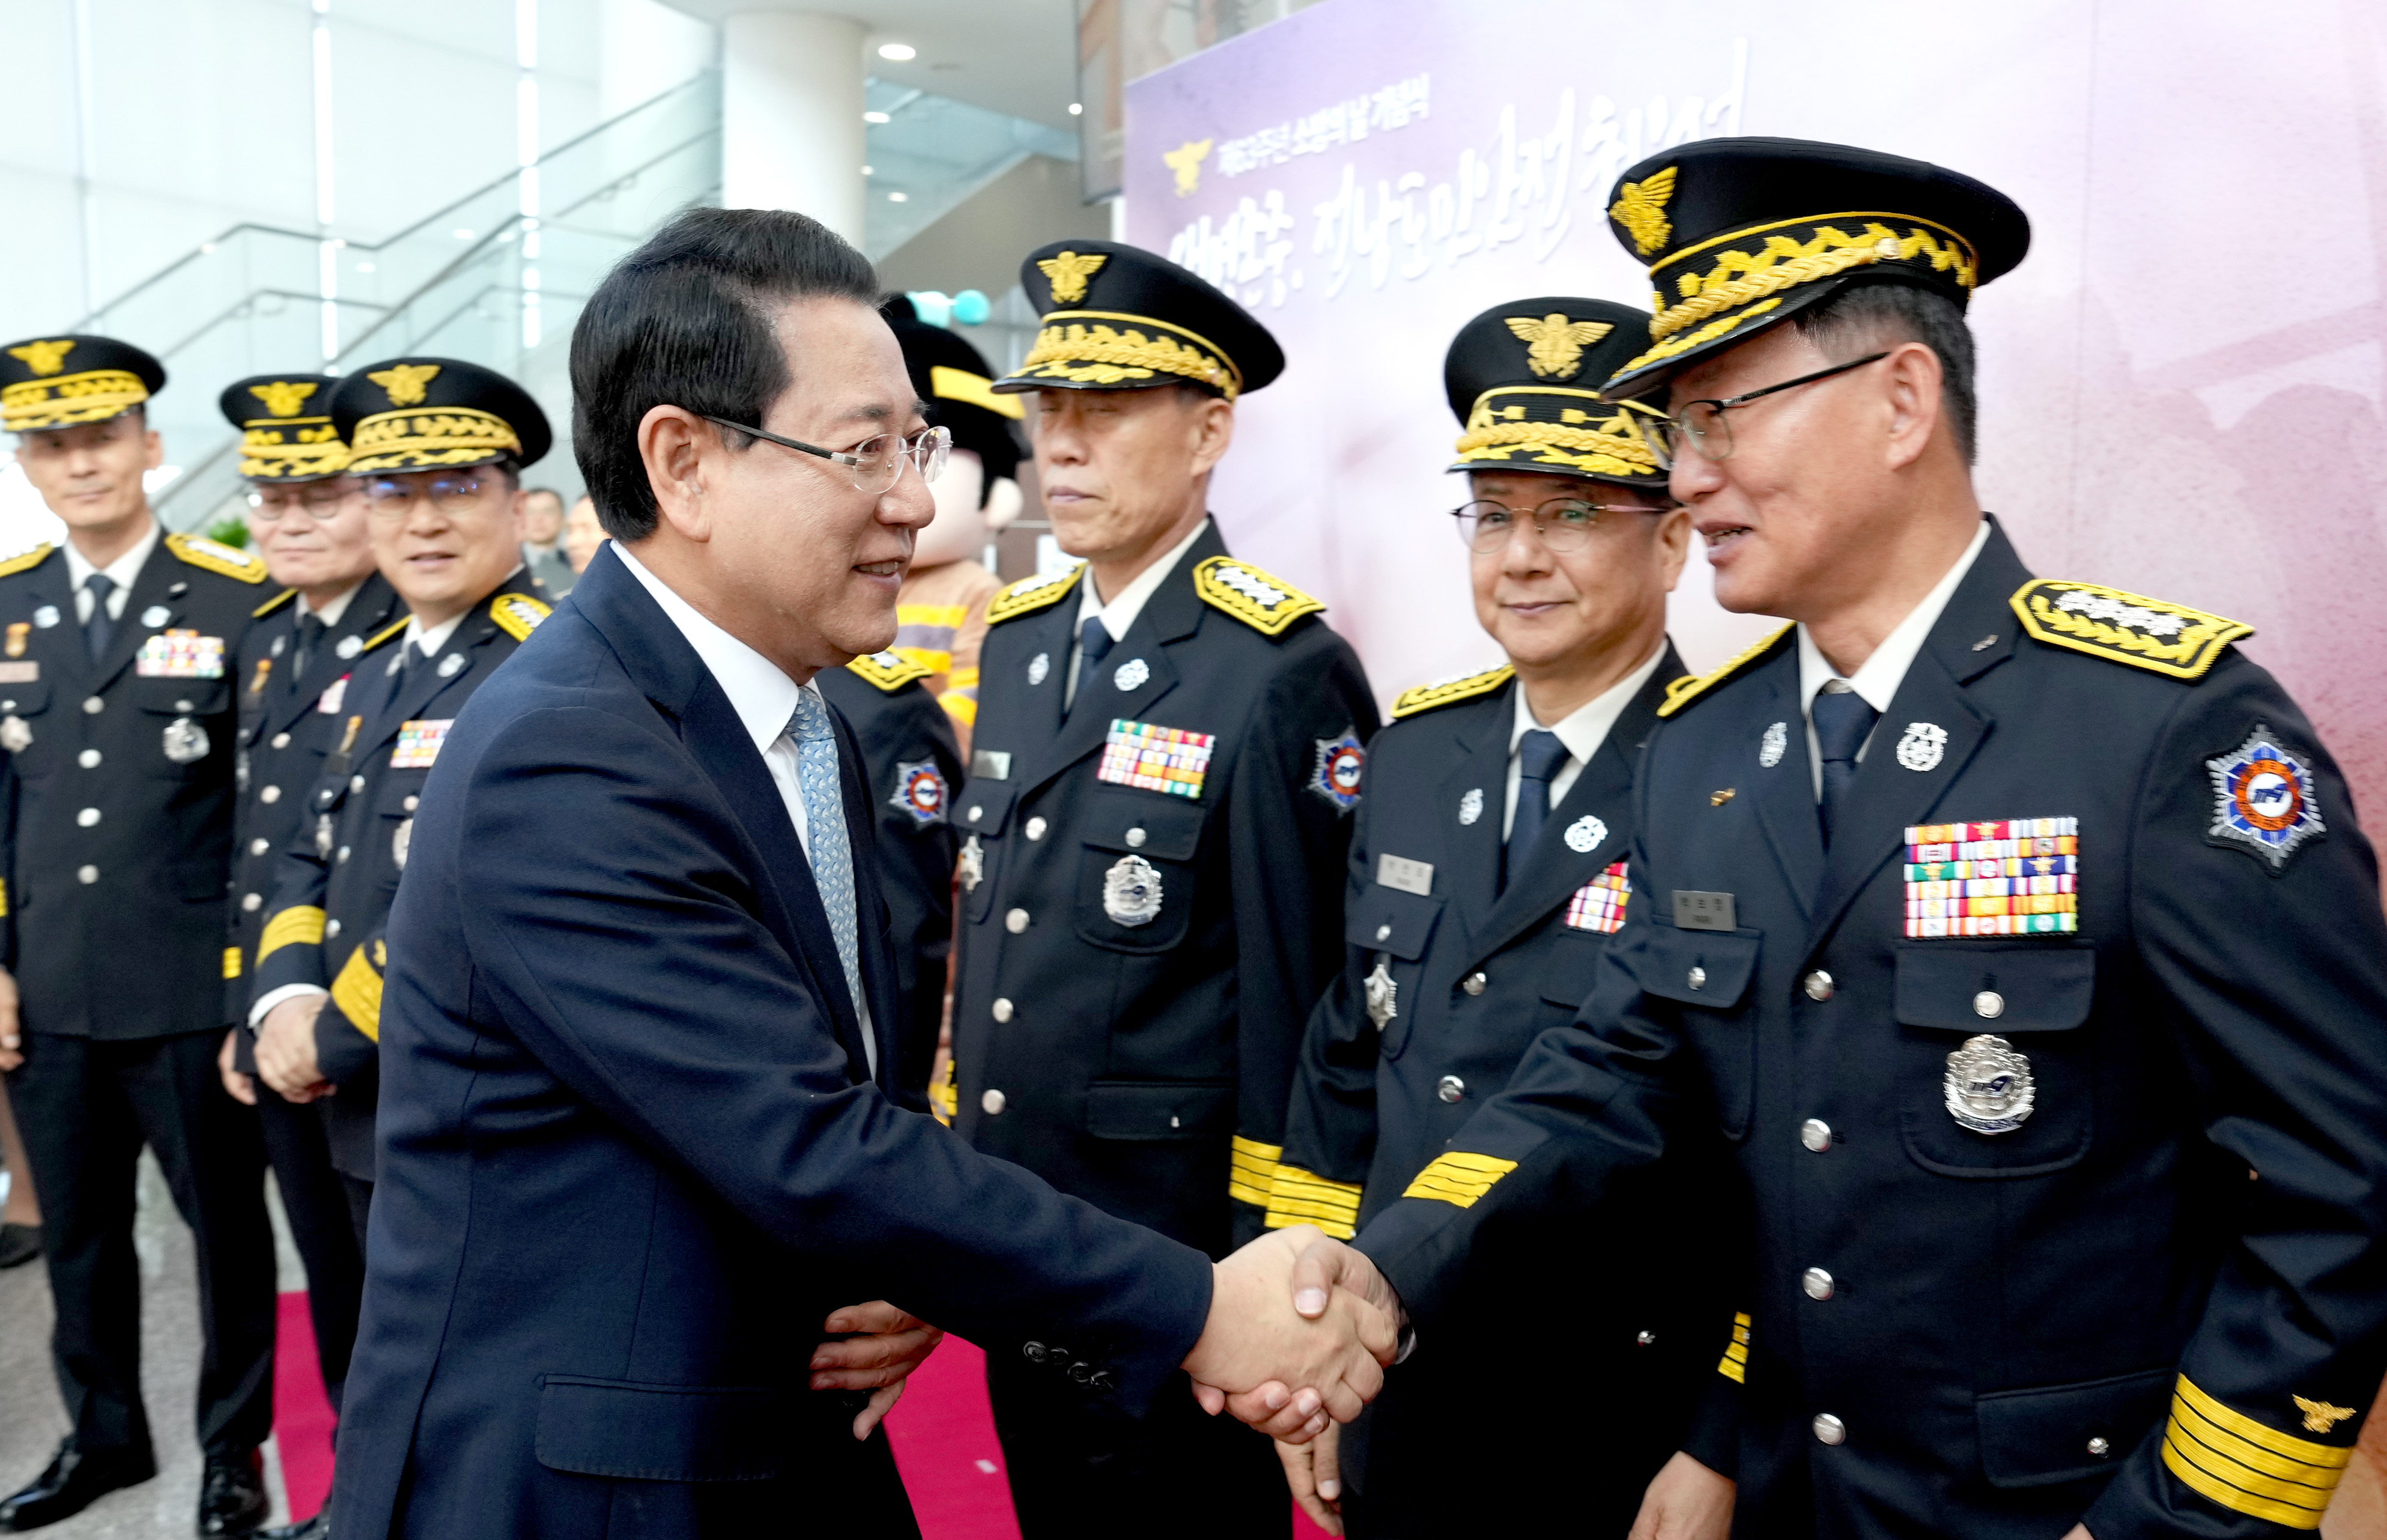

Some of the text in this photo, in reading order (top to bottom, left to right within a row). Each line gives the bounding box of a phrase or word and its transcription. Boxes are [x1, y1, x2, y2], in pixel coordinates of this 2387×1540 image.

[1291, 102, 1347, 155] 소방의
[1349, 95, 1369, 142] 날
[1370, 73, 1430, 132] 기념식
[1312, 148, 1484, 299] 전남도민
[1475, 86, 1575, 263] 안전
